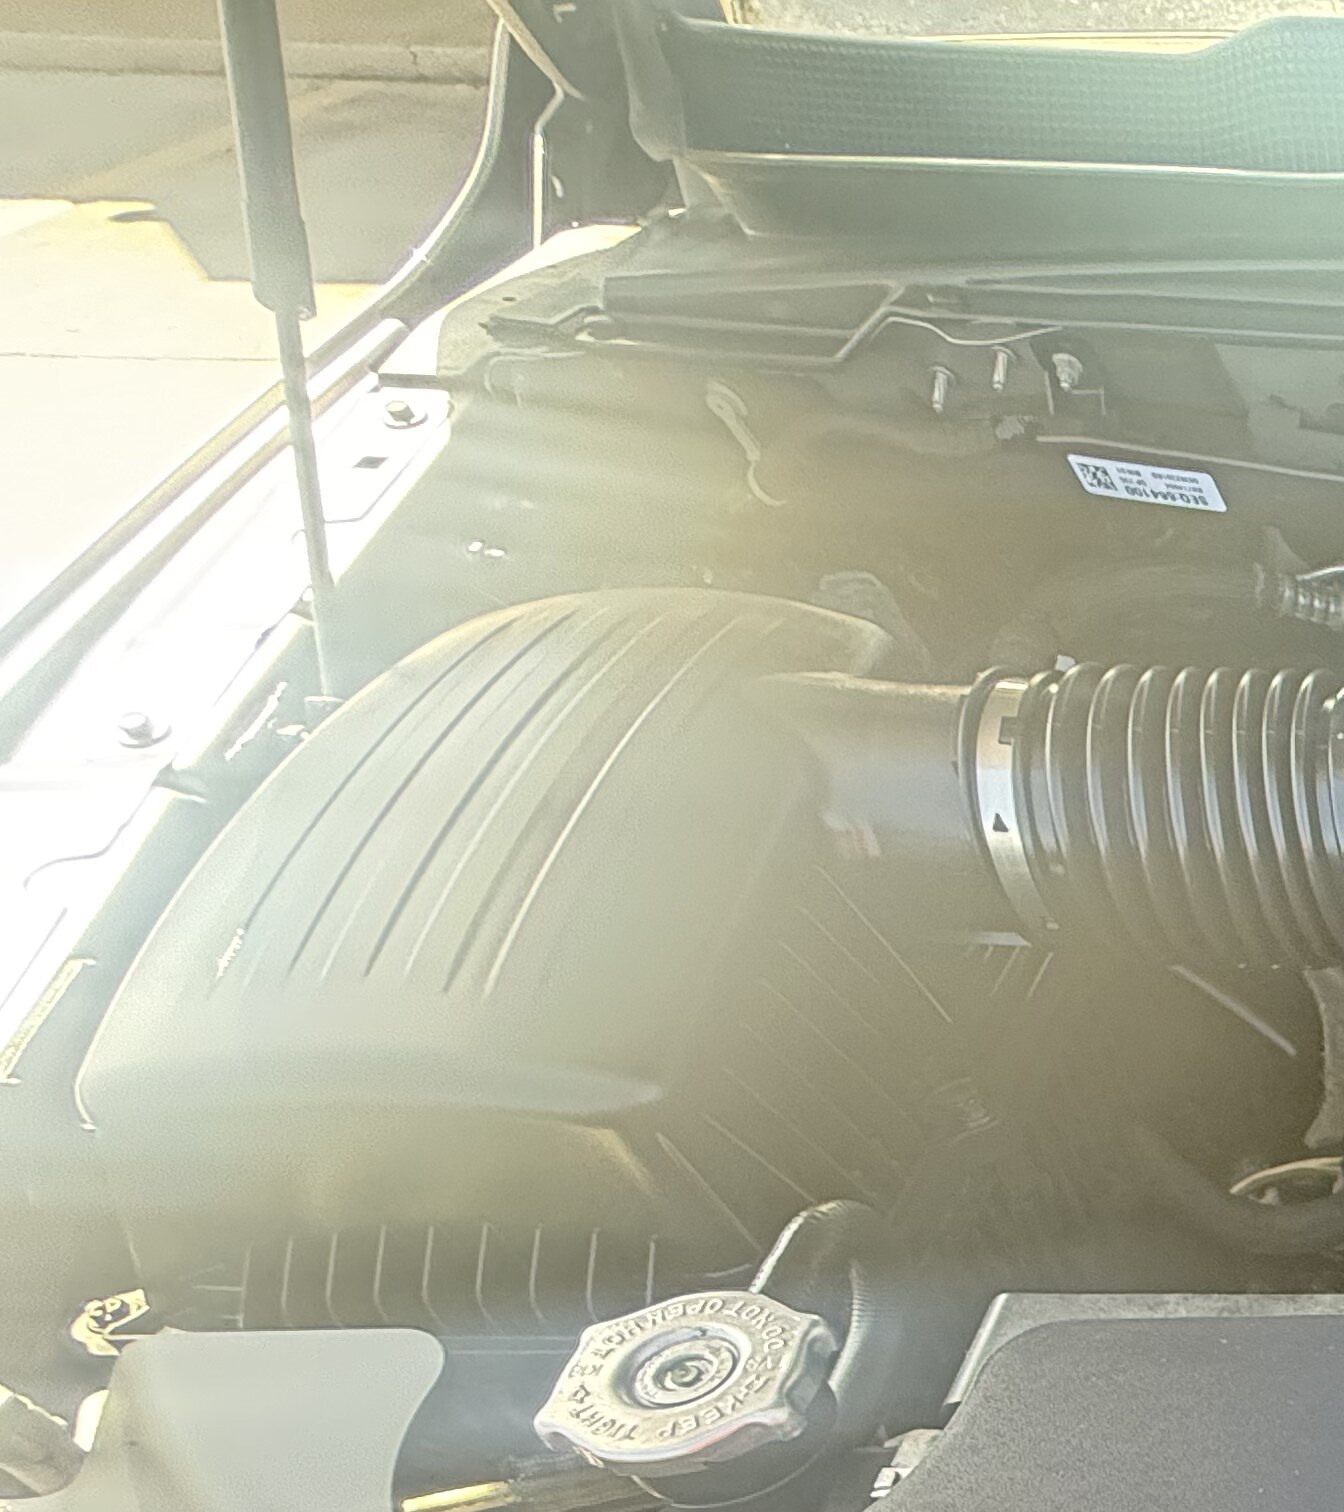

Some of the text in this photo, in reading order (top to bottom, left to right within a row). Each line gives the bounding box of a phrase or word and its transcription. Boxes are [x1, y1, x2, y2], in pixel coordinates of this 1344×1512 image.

[647, 1298, 723, 1326] OPEN
[723, 1299, 777, 1331] NOT
[595, 1318, 644, 1360] HOT
[568, 1394, 741, 1442] KEEP TIGHT
